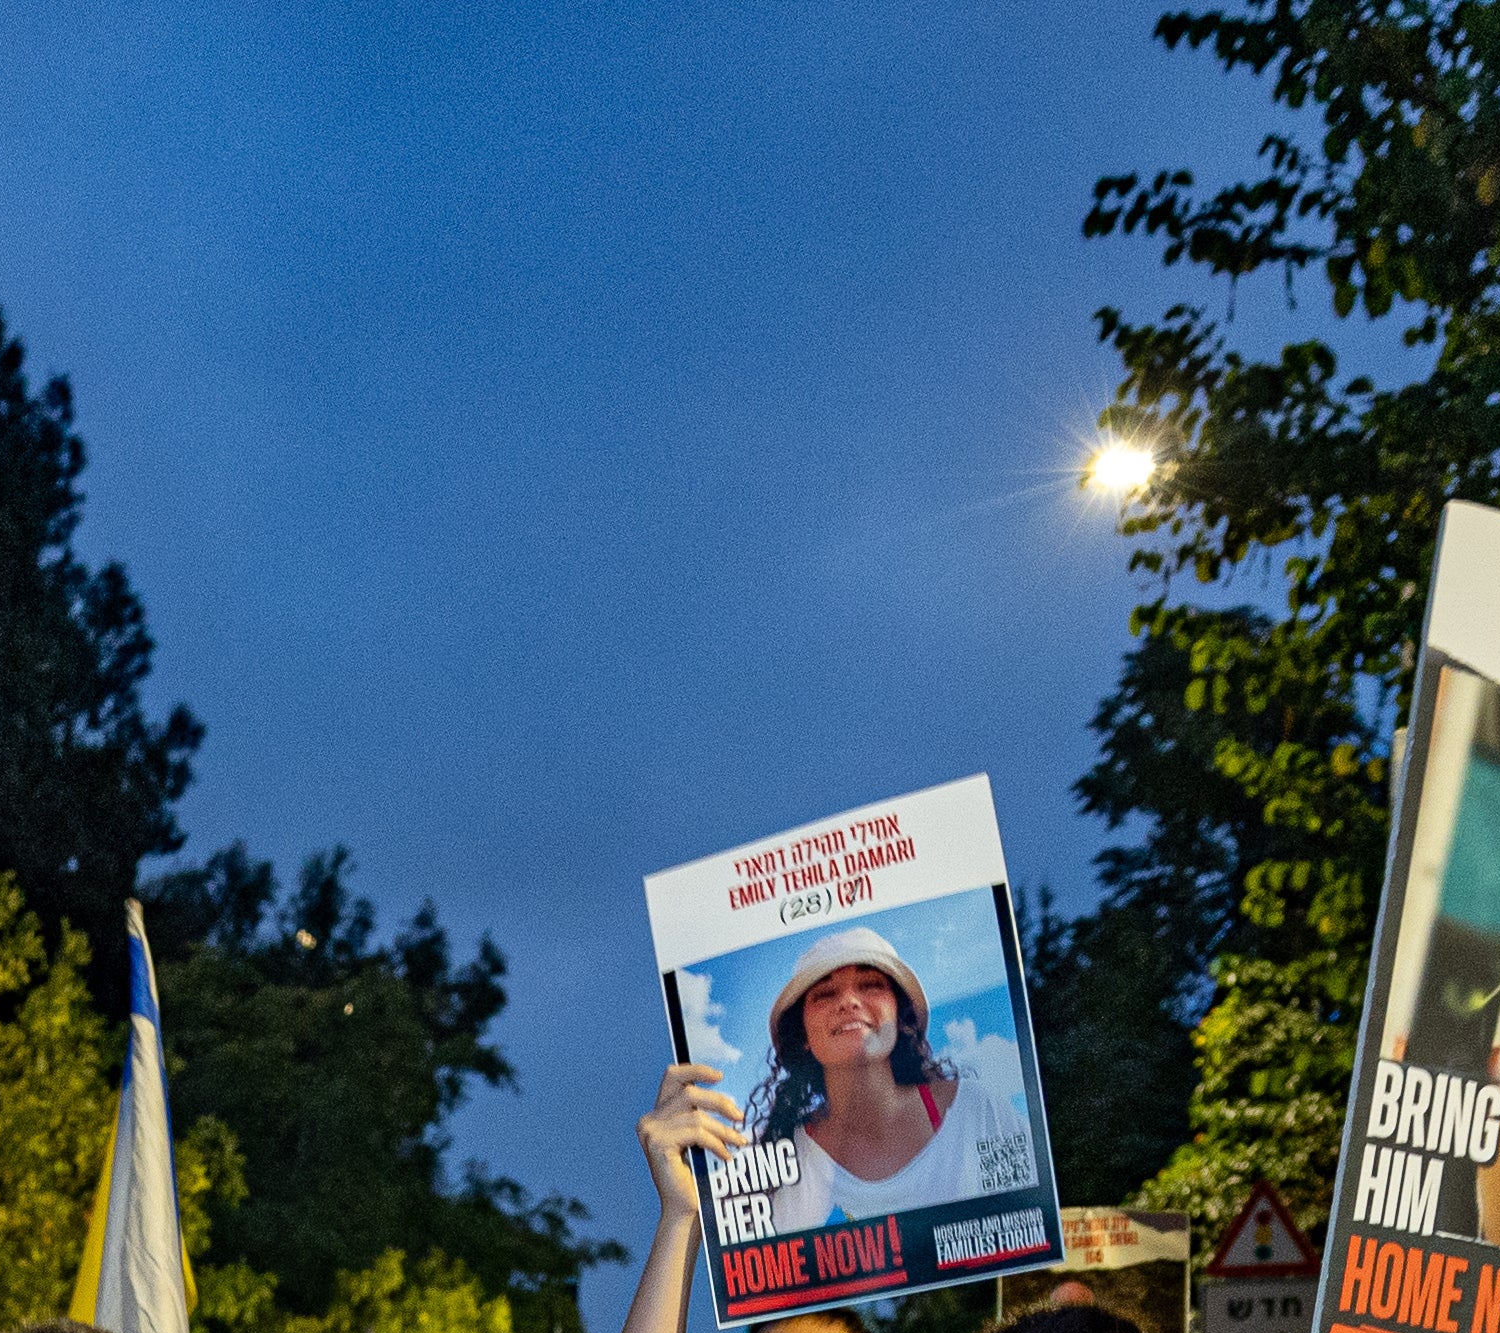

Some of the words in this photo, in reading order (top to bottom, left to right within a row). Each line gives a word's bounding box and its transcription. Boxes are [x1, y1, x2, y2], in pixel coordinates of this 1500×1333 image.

[850, 812, 902, 845] אמילי
[728, 876, 777, 911] EMILY
[782, 856, 841, 894] TEHILA
[843, 836, 916, 876] DAMARI
[778, 887, 833, 926] (28)
[708, 1138, 799, 1199] BRING
[1353, 1143, 1445, 1237] HIM
[716, 1193, 776, 1246] HER
[933, 1219, 981, 1244] HOSTAGES
[1002, 1207, 1044, 1231] MISSING
[937, 1235, 996, 1264] FAMILIES
[999, 1225, 1046, 1254] FORUM
[722, 1238, 809, 1298] HOME
[813, 1214, 904, 1279] NOW!
[1227, 1296, 1301, 1320] חדש
[1339, 1234, 1469, 1333] HOME
